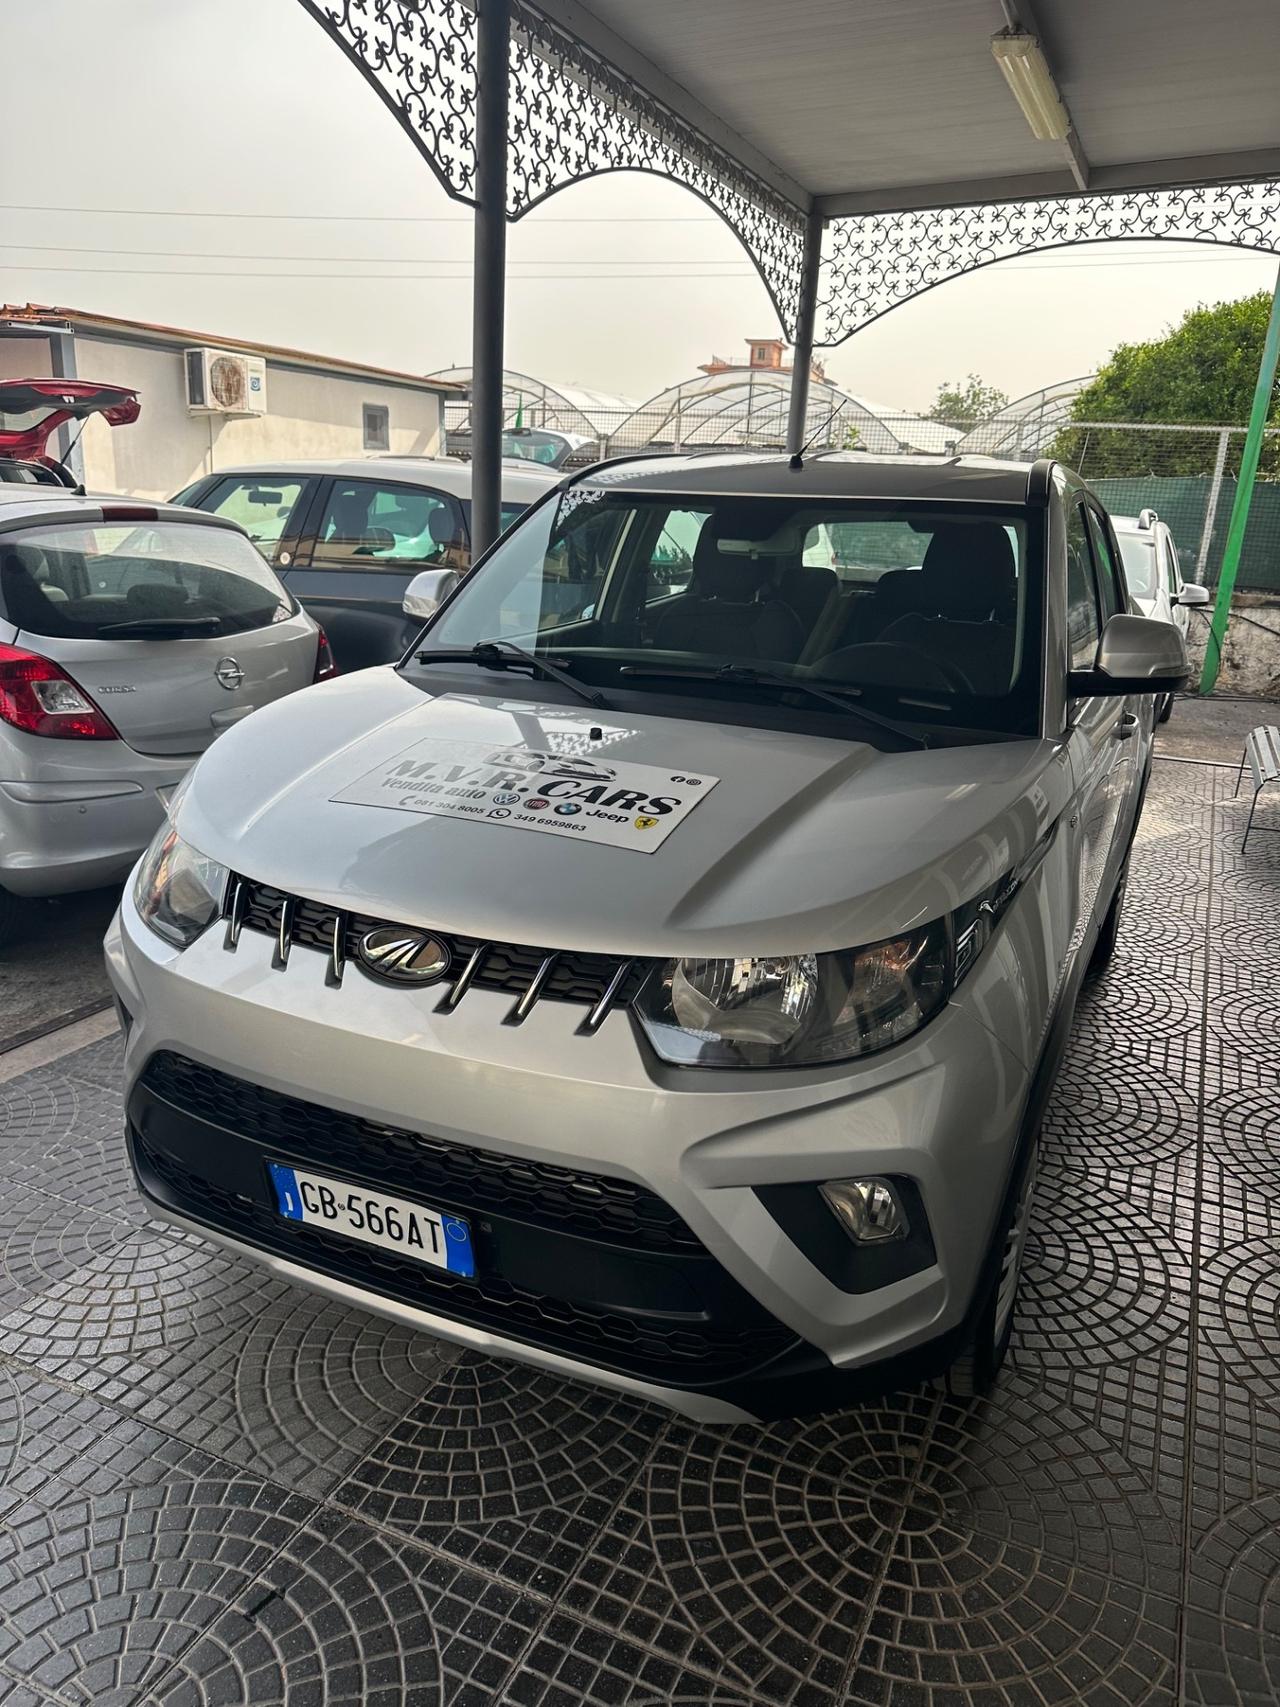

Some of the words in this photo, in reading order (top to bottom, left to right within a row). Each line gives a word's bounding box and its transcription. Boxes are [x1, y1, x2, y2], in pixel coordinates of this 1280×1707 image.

[381, 777, 444, 794] Vendita
[444, 786, 487, 800] auto
[457, 805, 486, 814] 8005
[585, 809, 630, 823] Jeep
[513, 813, 536, 822] 349
[537, 817, 587, 832] 6959863
